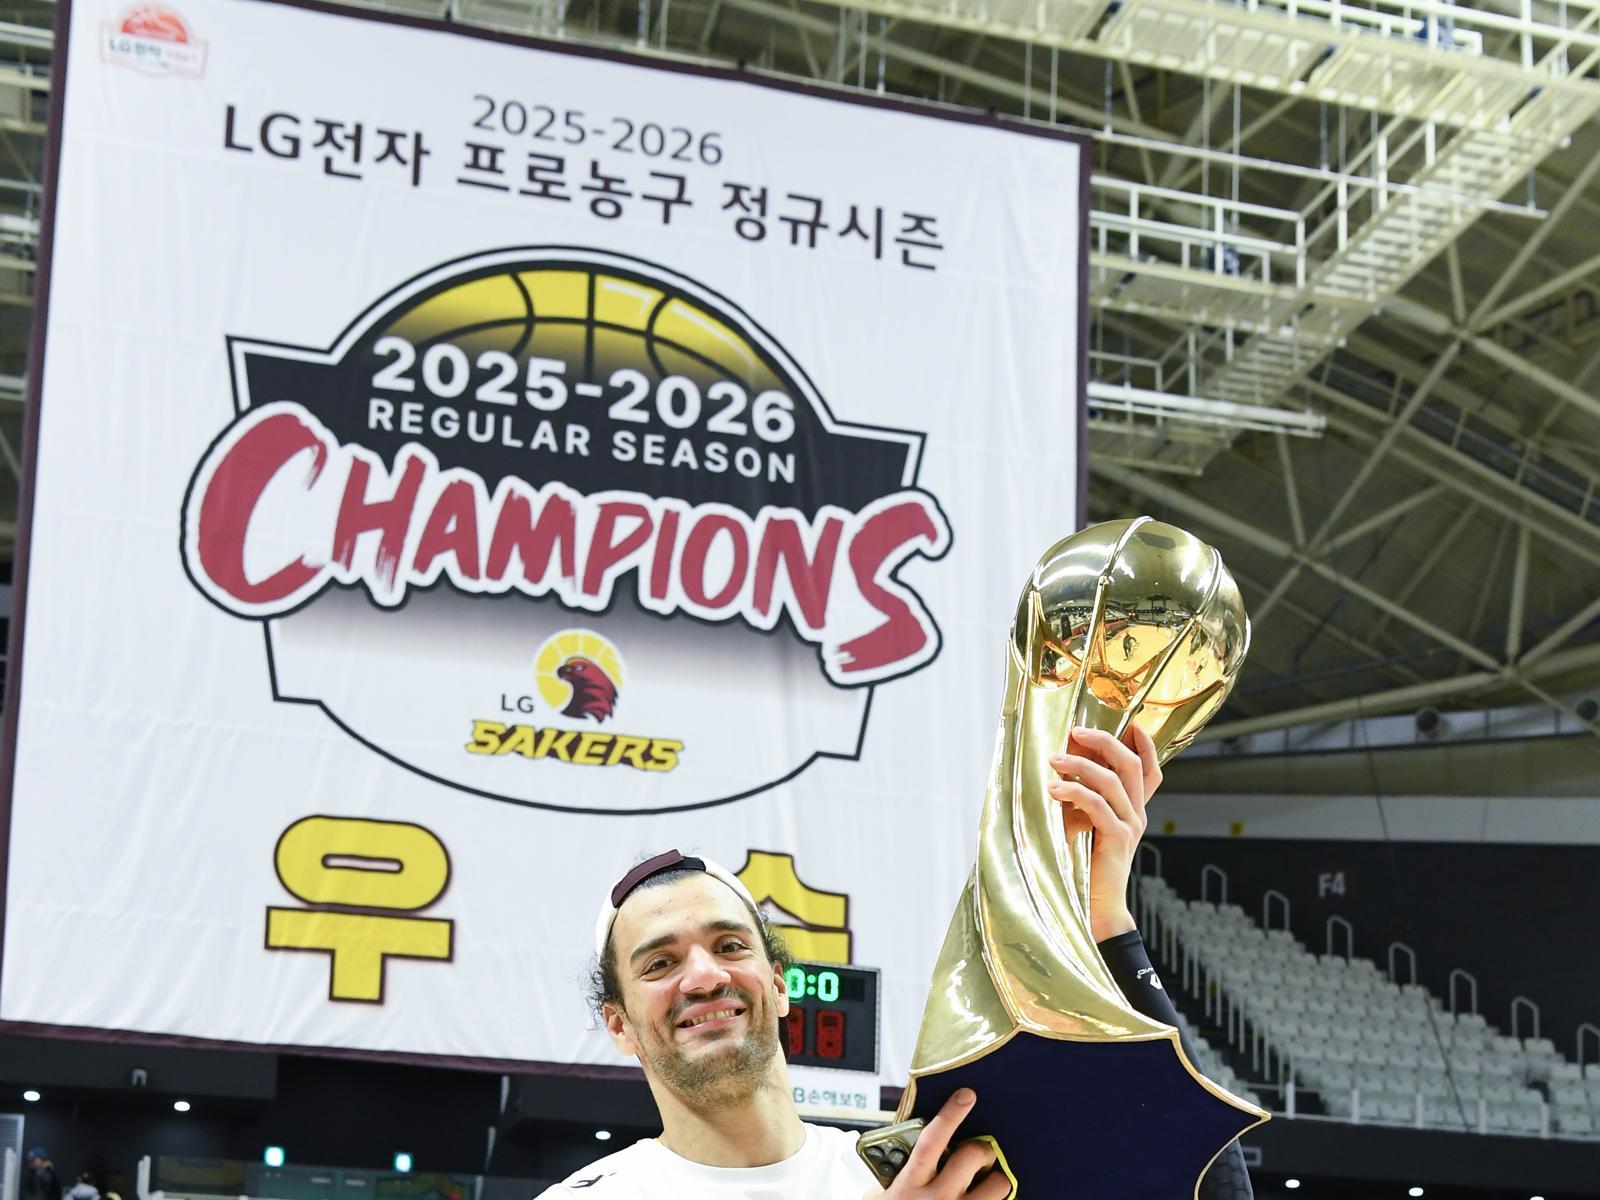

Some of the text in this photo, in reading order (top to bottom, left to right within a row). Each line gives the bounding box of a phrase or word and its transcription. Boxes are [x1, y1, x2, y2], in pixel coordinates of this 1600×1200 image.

[471, 93, 724, 166] 2025-2026
[223, 104, 944, 271] LG전자 프로농구 정규시즌
[371, 335, 796, 443] 2025-2026
[368, 398, 796, 484] REGULAR SEASON
[198, 413, 940, 674] CHAMPIONS
[464, 719, 685, 773] SAKERS
[500, 693, 535, 714] LG
[264, 814, 455, 1005] 우
[1318, 871, 1345, 897] F4
